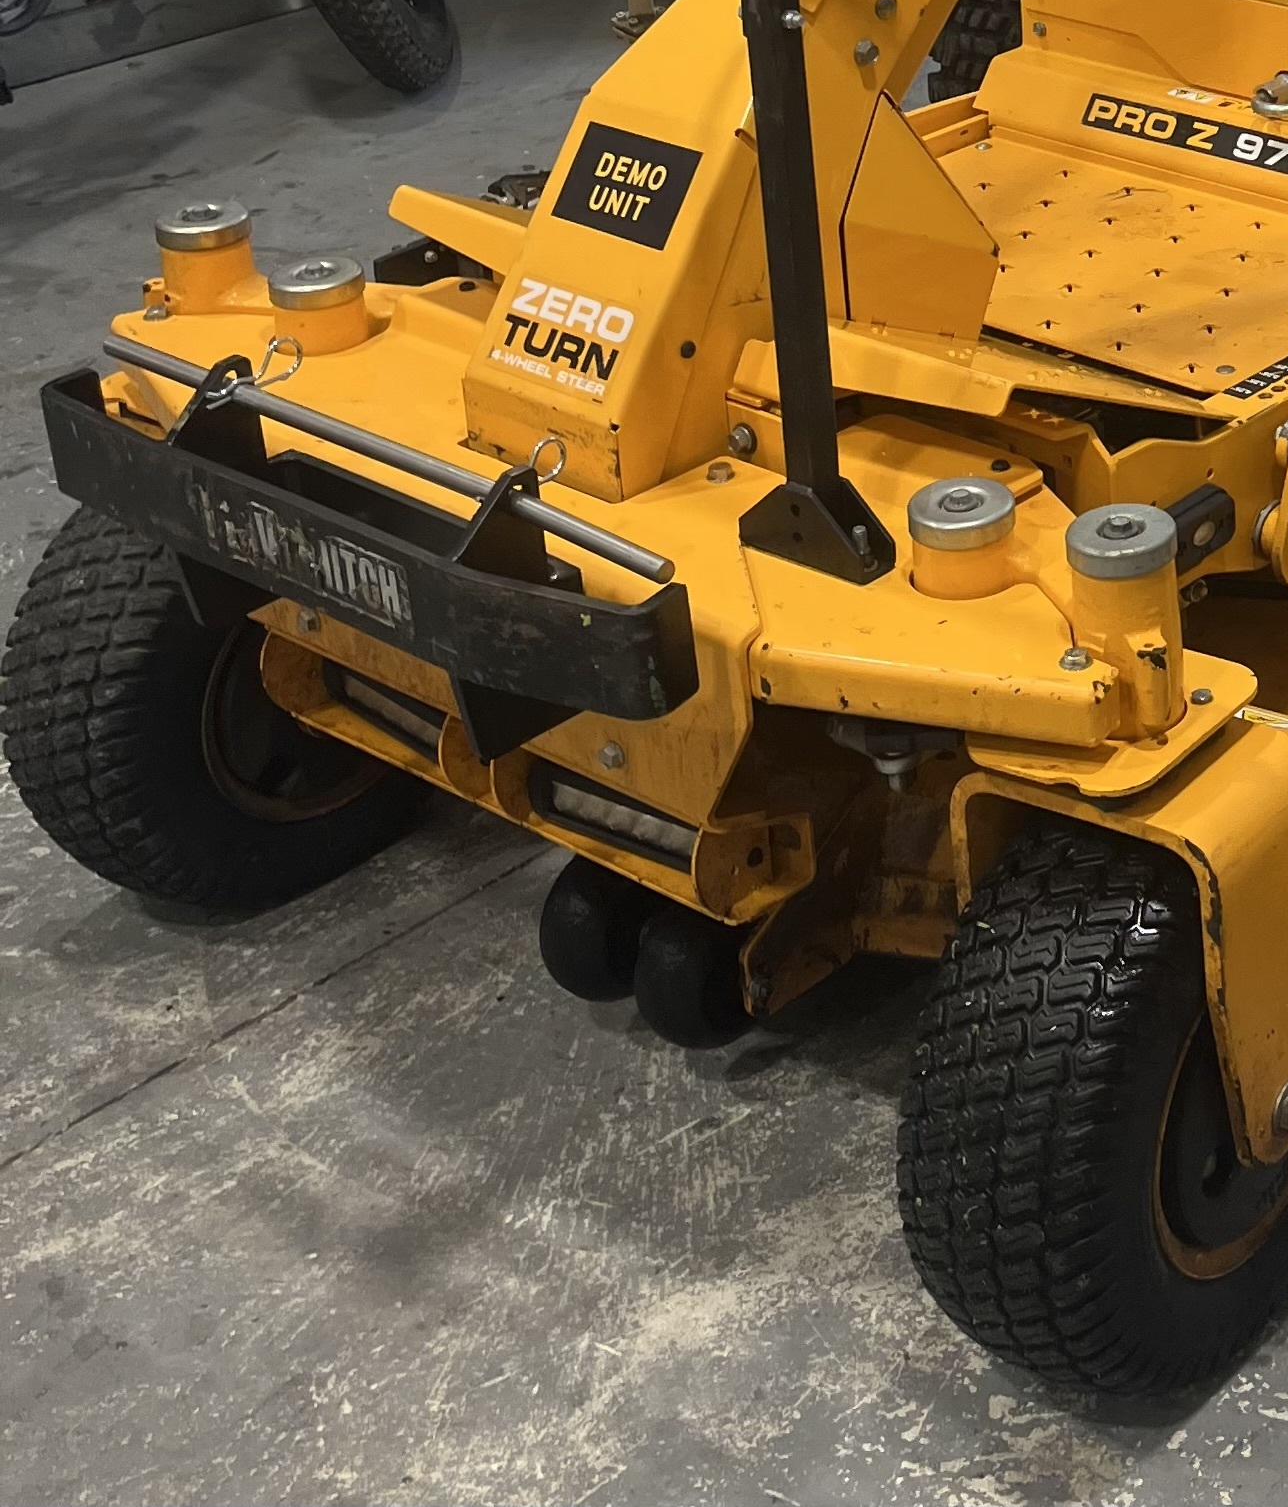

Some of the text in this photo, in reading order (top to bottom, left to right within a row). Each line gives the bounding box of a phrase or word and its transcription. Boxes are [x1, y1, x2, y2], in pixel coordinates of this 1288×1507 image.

[1087, 98, 1177, 140] PRO
[1185, 122, 1219, 151] Z
[594, 151, 668, 191] DEMO
[588, 184, 651, 221] UNIT
[511, 277, 635, 343] ZERO
[503, 312, 620, 381] TURN
[490, 348, 606, 396] 4-WHEEL STEER
